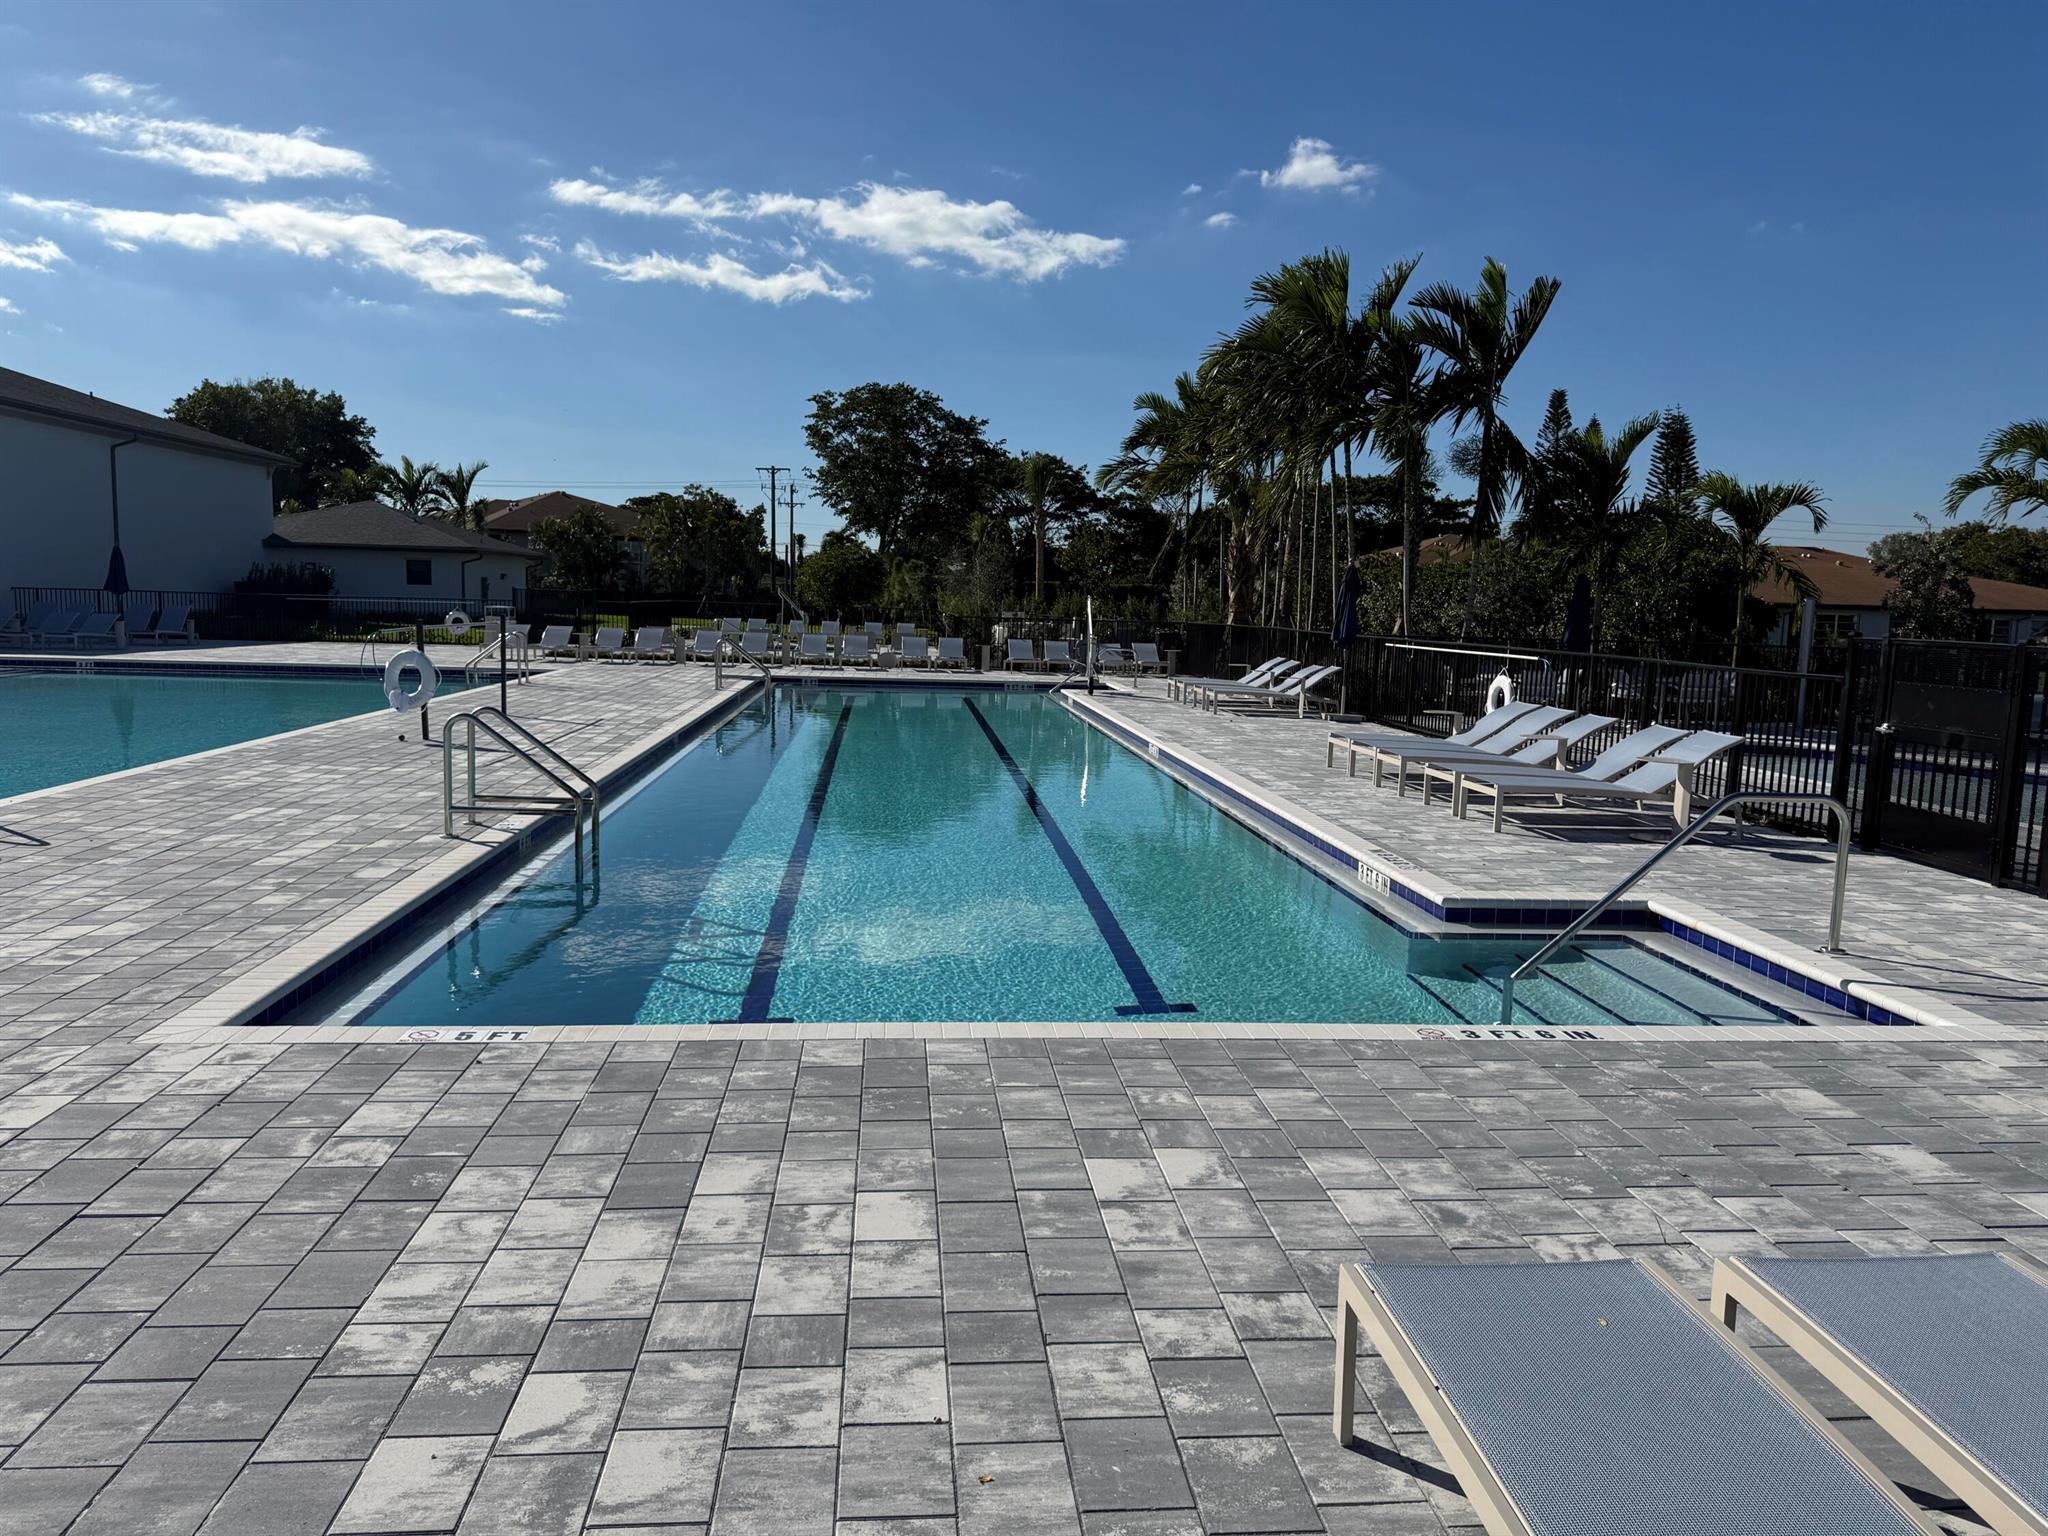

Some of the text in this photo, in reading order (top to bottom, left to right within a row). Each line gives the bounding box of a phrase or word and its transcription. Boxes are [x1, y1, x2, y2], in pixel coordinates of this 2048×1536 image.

[454, 1031, 477, 1041] 5
[1460, 1030, 1481, 1039] 3
[1488, 1030, 1529, 1039] FT.
[1534, 1030, 1557, 1039] 6
[1562, 1030, 1604, 1040] IN.
